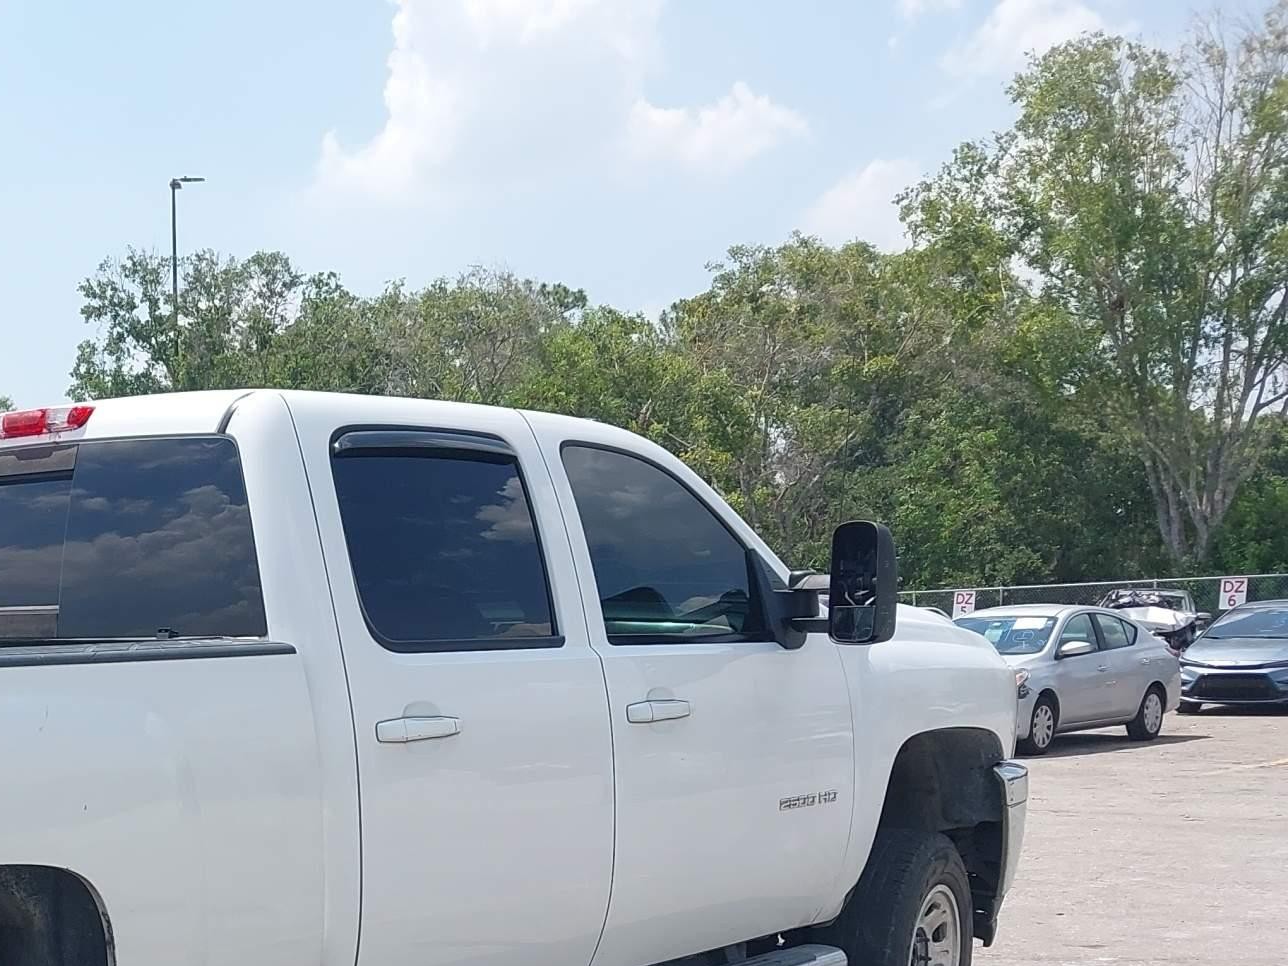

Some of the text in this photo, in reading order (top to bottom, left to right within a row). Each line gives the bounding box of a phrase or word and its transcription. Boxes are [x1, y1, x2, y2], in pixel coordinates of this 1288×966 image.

[1223, 580, 1245, 593] DZ
[956, 592, 974, 605] DZ
[1227, 594, 1236, 607] 6
[818, 789, 838, 804] HD
